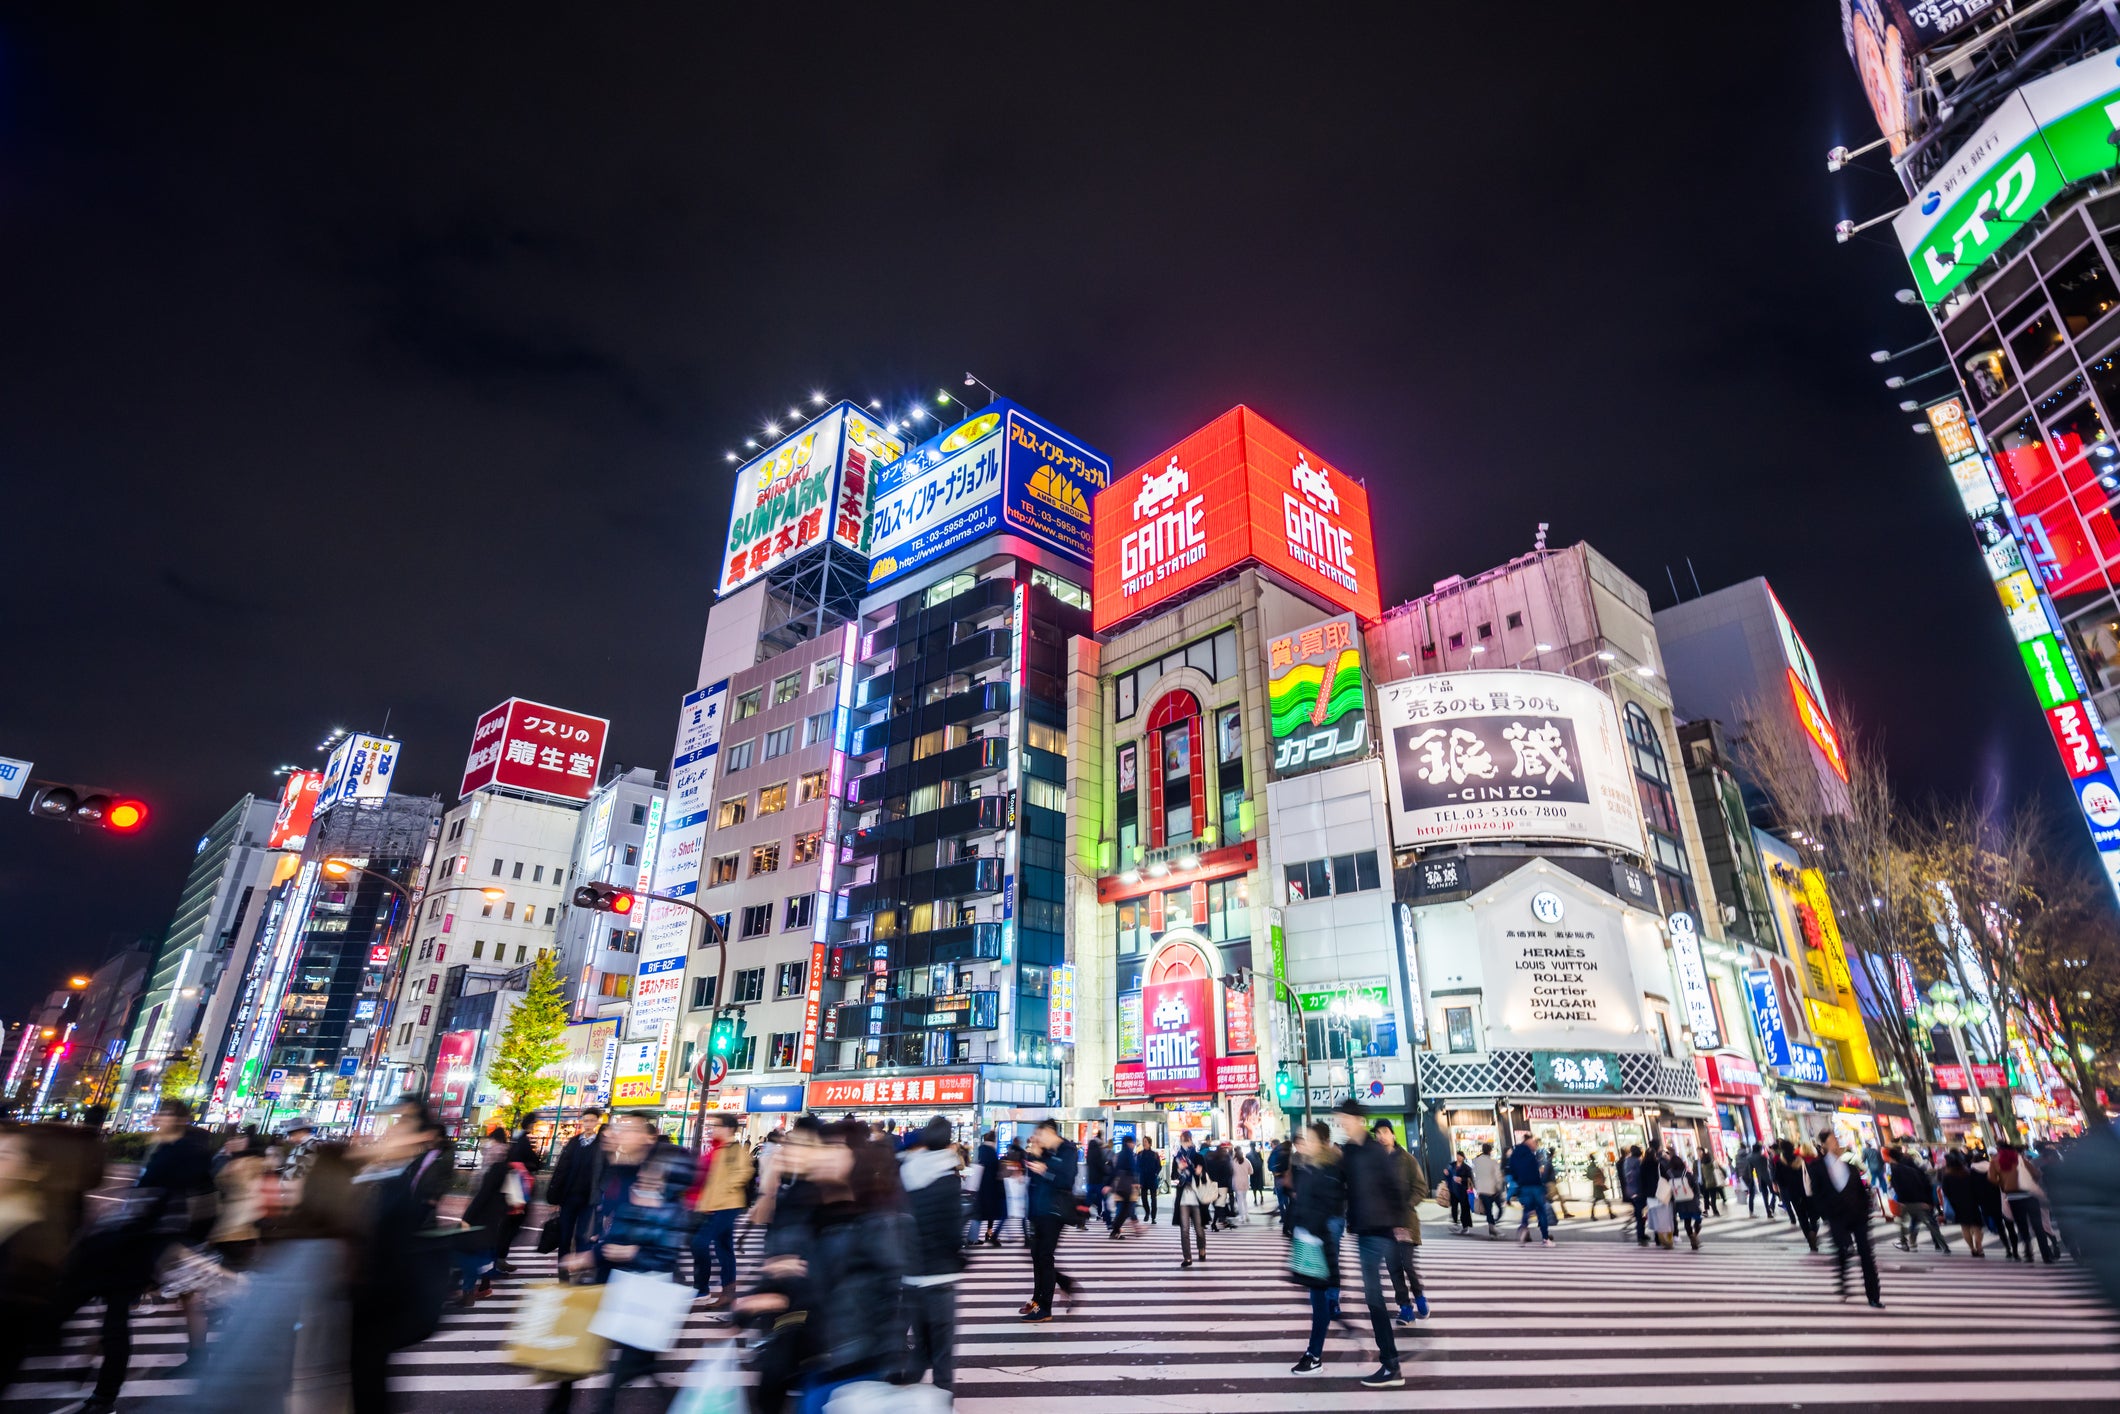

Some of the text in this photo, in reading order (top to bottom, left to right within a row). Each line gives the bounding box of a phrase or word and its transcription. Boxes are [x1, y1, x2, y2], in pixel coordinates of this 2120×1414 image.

[1944, 130, 2000, 193] 新生銀行
[1923, 151, 2036, 286] レイク
[1011, 422, 1106, 488] アムス・インターナショナル
[757, 465, 810, 506] SHINJUKU
[872, 448, 998, 544] アムス・インターナショナル
[730, 465, 832, 552] SUNPARK
[1036, 493, 1084, 520] AMMS GROUP
[899, 516, 996, 570] http://www.amms.co.jp
[1122, 494, 1205, 581] GAME
[1283, 492, 1356, 576] GAME
[1122, 543, 1206, 598] TAITO STATION
[1287, 540, 1358, 594] TAITO STATION
[1270, 622, 1352, 670] 質・買取
[1389, 680, 1454, 700] ブランド品
[476, 716, 505, 741] クスリの
[524, 716, 590, 742] クスリの
[1275, 720, 1366, 769] カワノ
[505, 738, 595, 778] 龍生堂
[1408, 720, 1575, 785] 銀蔵
[1417, 820, 1514, 836] http://ginzo.jp
[1516, 960, 1598, 970] LOUIS VUITTON
[1534, 973, 1584, 983] ROLEX
[1530, 998, 1596, 1008] BVLGARI
[1534, 985, 1588, 996] Cartier
[1534, 1010, 1596, 1021] CHANEL
[1146, 1031, 1200, 1068] GAME
[1760, 1008, 1778, 1064] バイオリン
[270, 1071, 282, 1082] P
[1146, 1067, 1200, 1081] TAITO STATION
[723, 1102, 740, 1110] GAME
[1526, 1104, 1553, 1119] Xmas
[1556, 1105, 1584, 1120] SALE!
